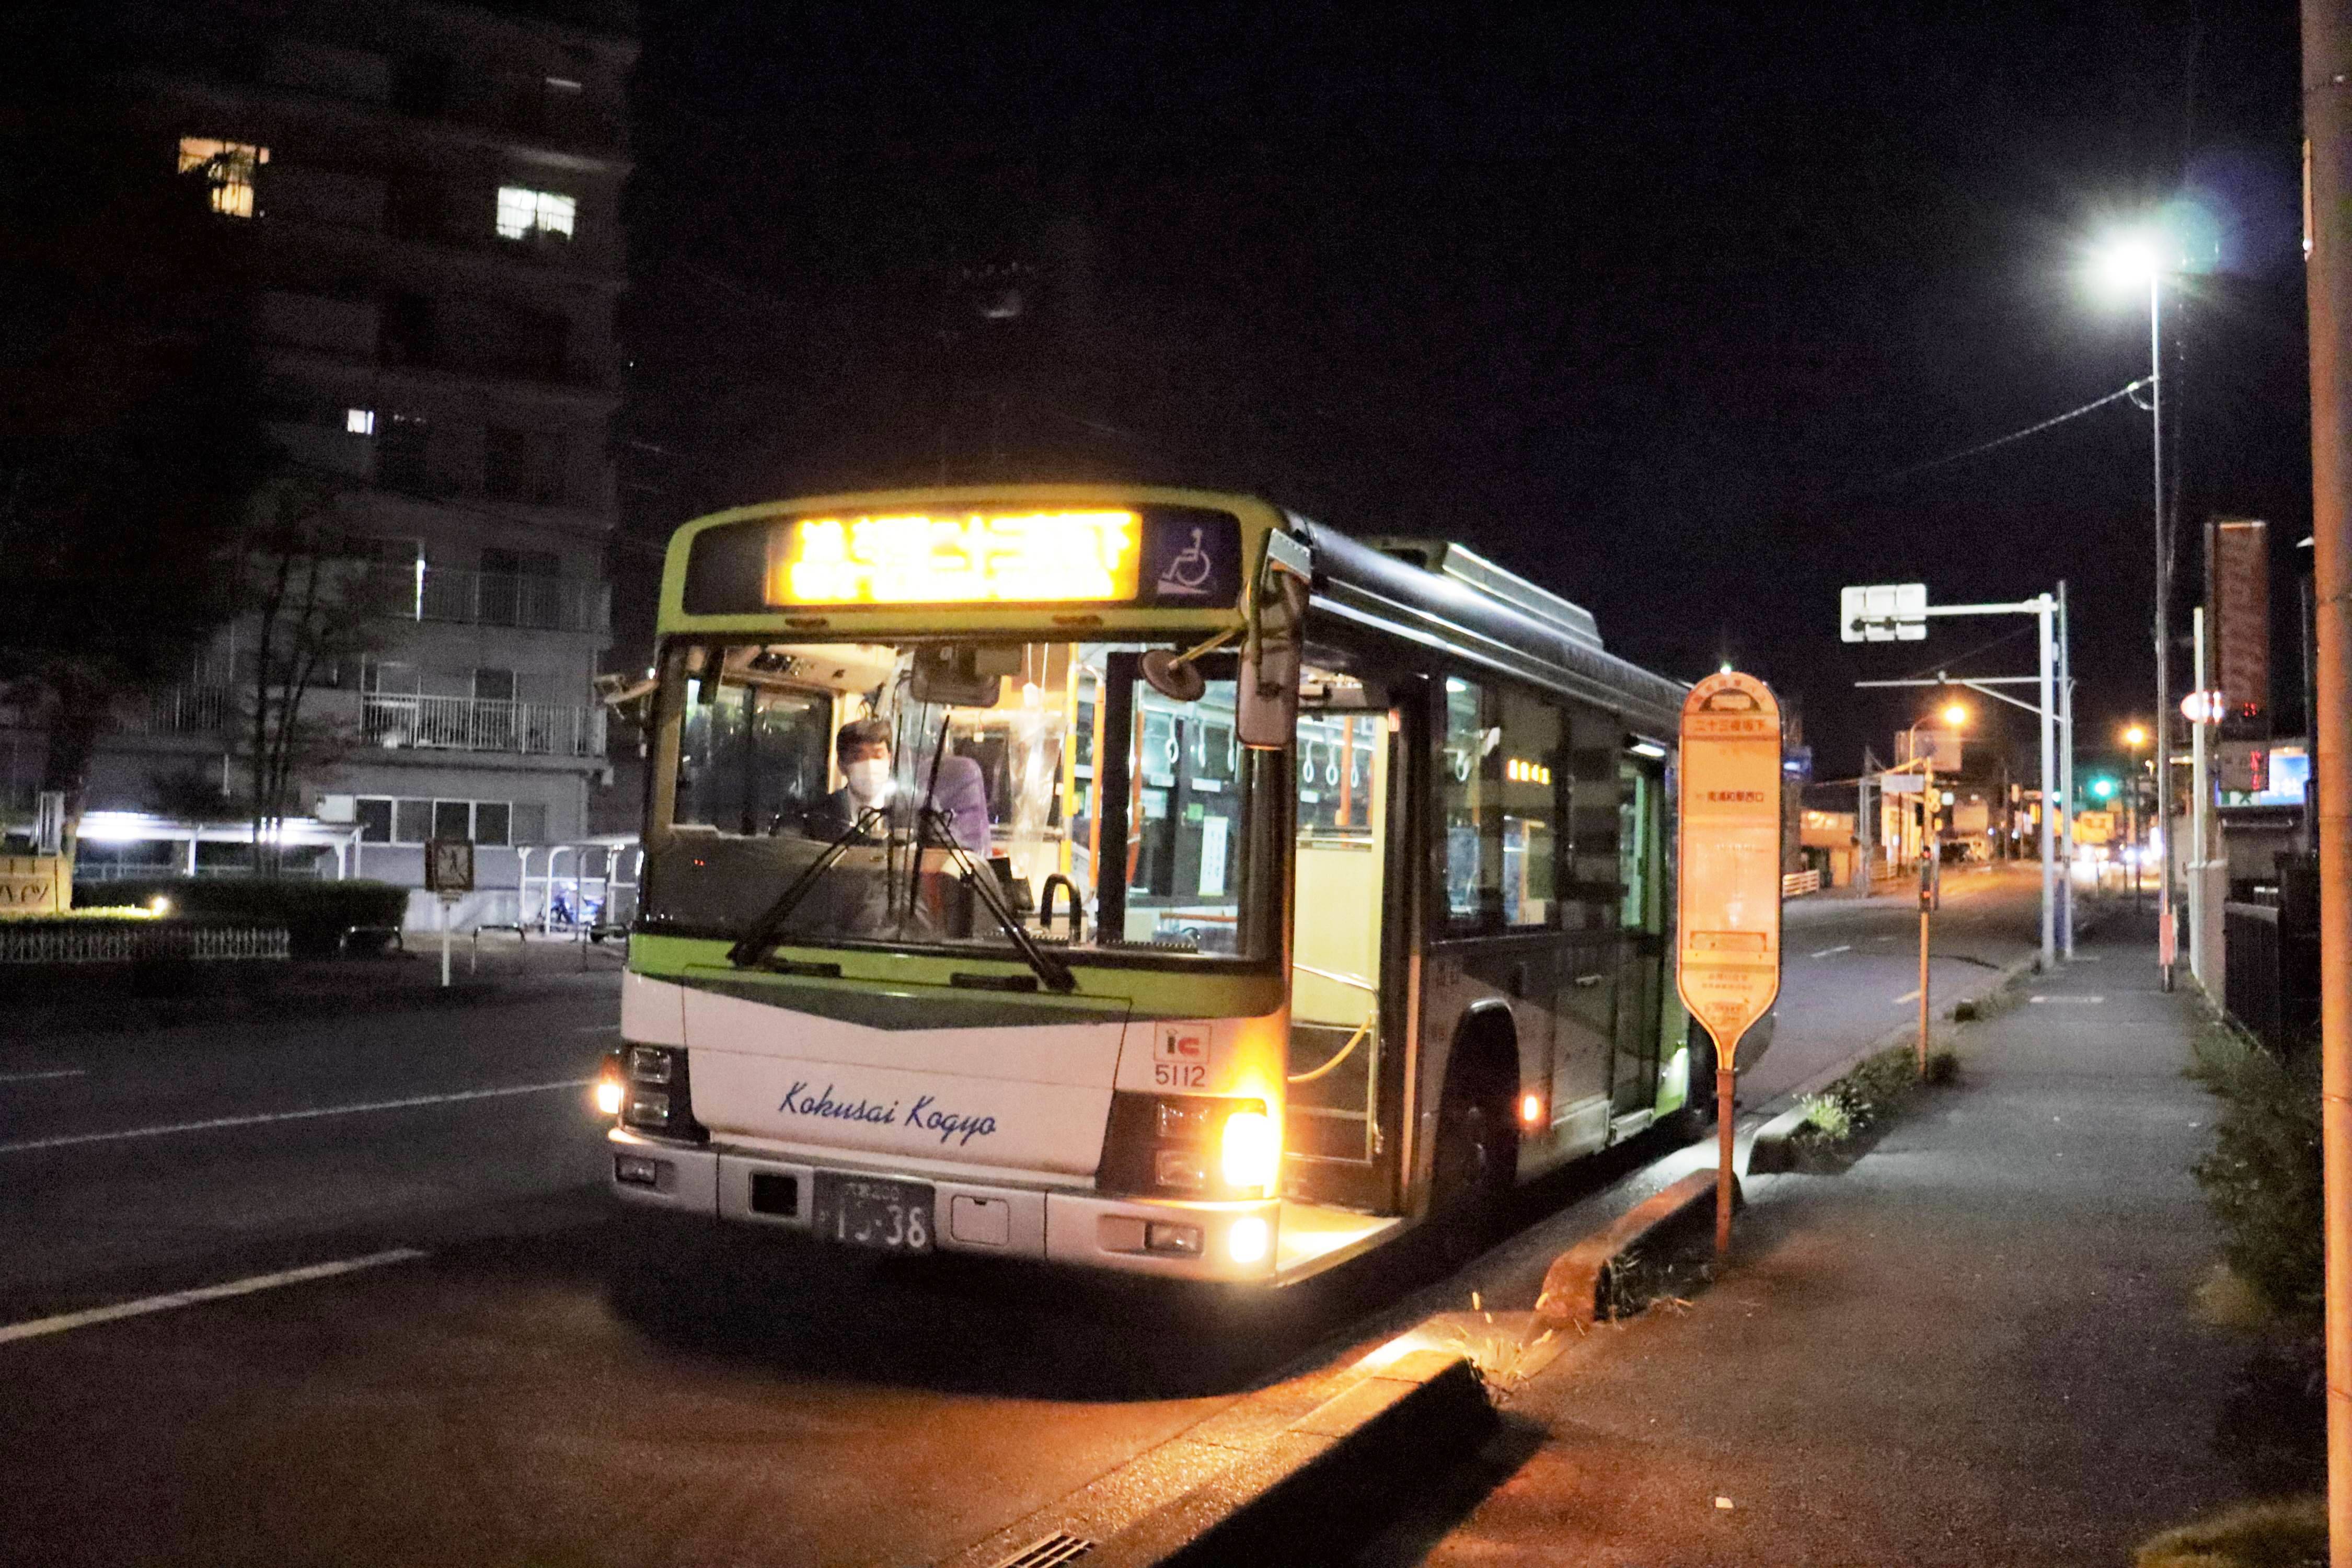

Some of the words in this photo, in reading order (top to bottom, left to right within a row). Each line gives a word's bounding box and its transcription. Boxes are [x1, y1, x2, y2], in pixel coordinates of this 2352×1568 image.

[1156, 1064, 1205, 1087] 5112
[778, 1081, 898, 1124] Kokusai
[904, 1096, 996, 1146] Kogyo
